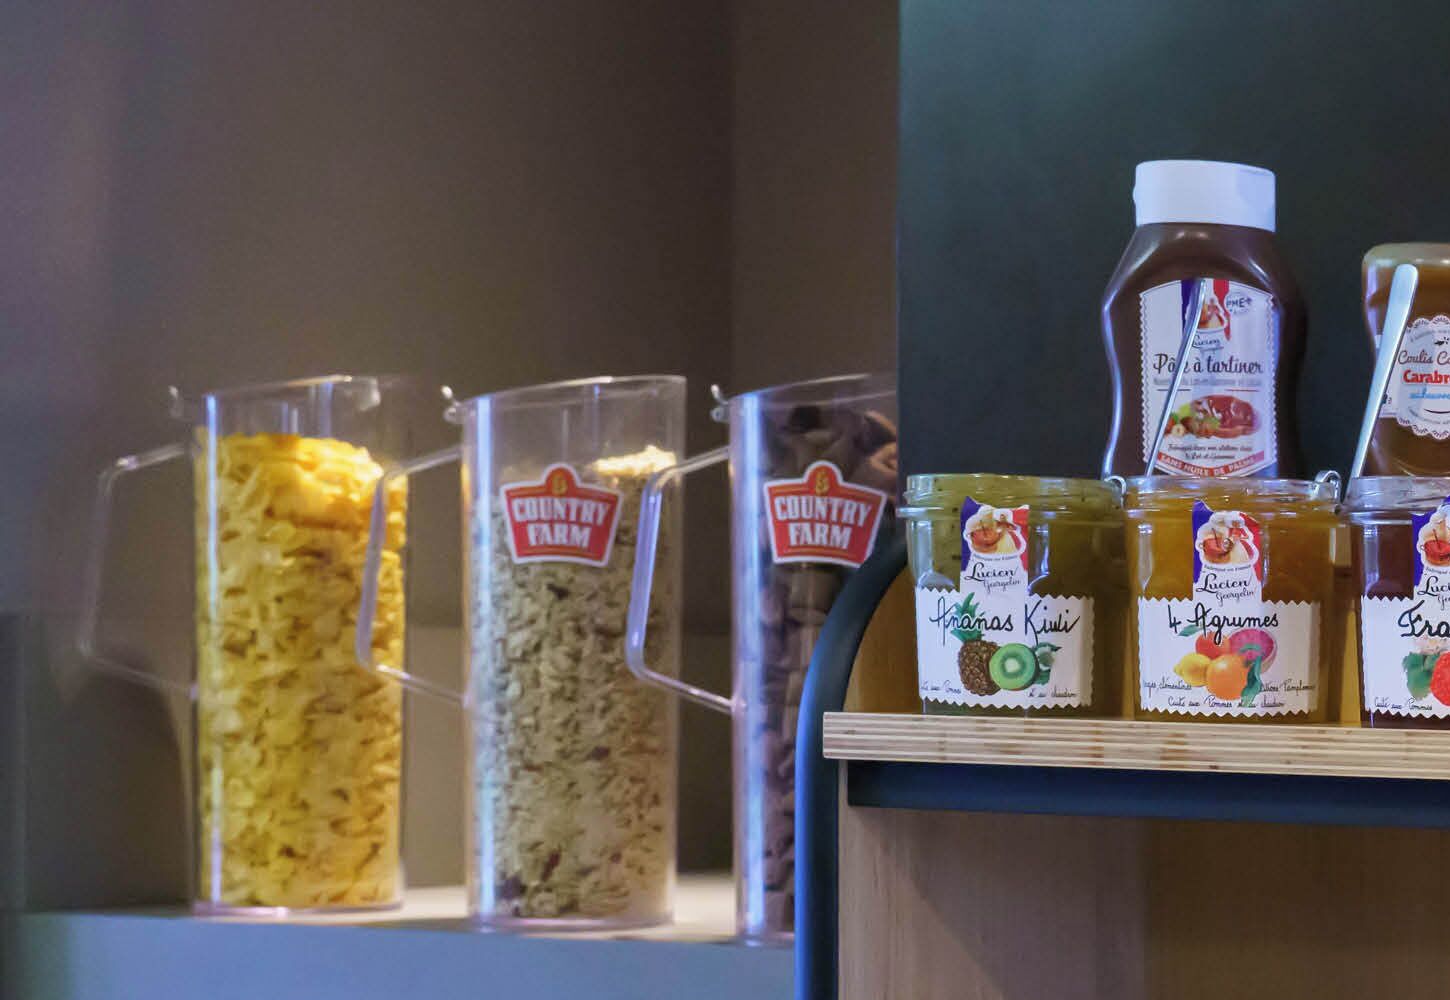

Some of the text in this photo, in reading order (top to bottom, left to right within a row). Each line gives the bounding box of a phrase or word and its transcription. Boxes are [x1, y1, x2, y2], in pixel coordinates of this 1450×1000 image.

[1153, 353, 1264, 375] Pâe à tartiner
[1398, 350, 1433, 365] Coulis
[512, 496, 609, 526] COUNTRY
[774, 494, 870, 527] COUNTRY
[528, 525, 590, 549] FARM
[789, 523, 852, 550] FARM
[964, 562, 1018, 582] Lucien
[1196, 573, 1250, 594] Lucien
[1215, 588, 1255, 607] Georgelin
[930, 596, 1081, 647] Ananas Kiwi
[1168, 602, 1279, 646] 4 Agrumes
